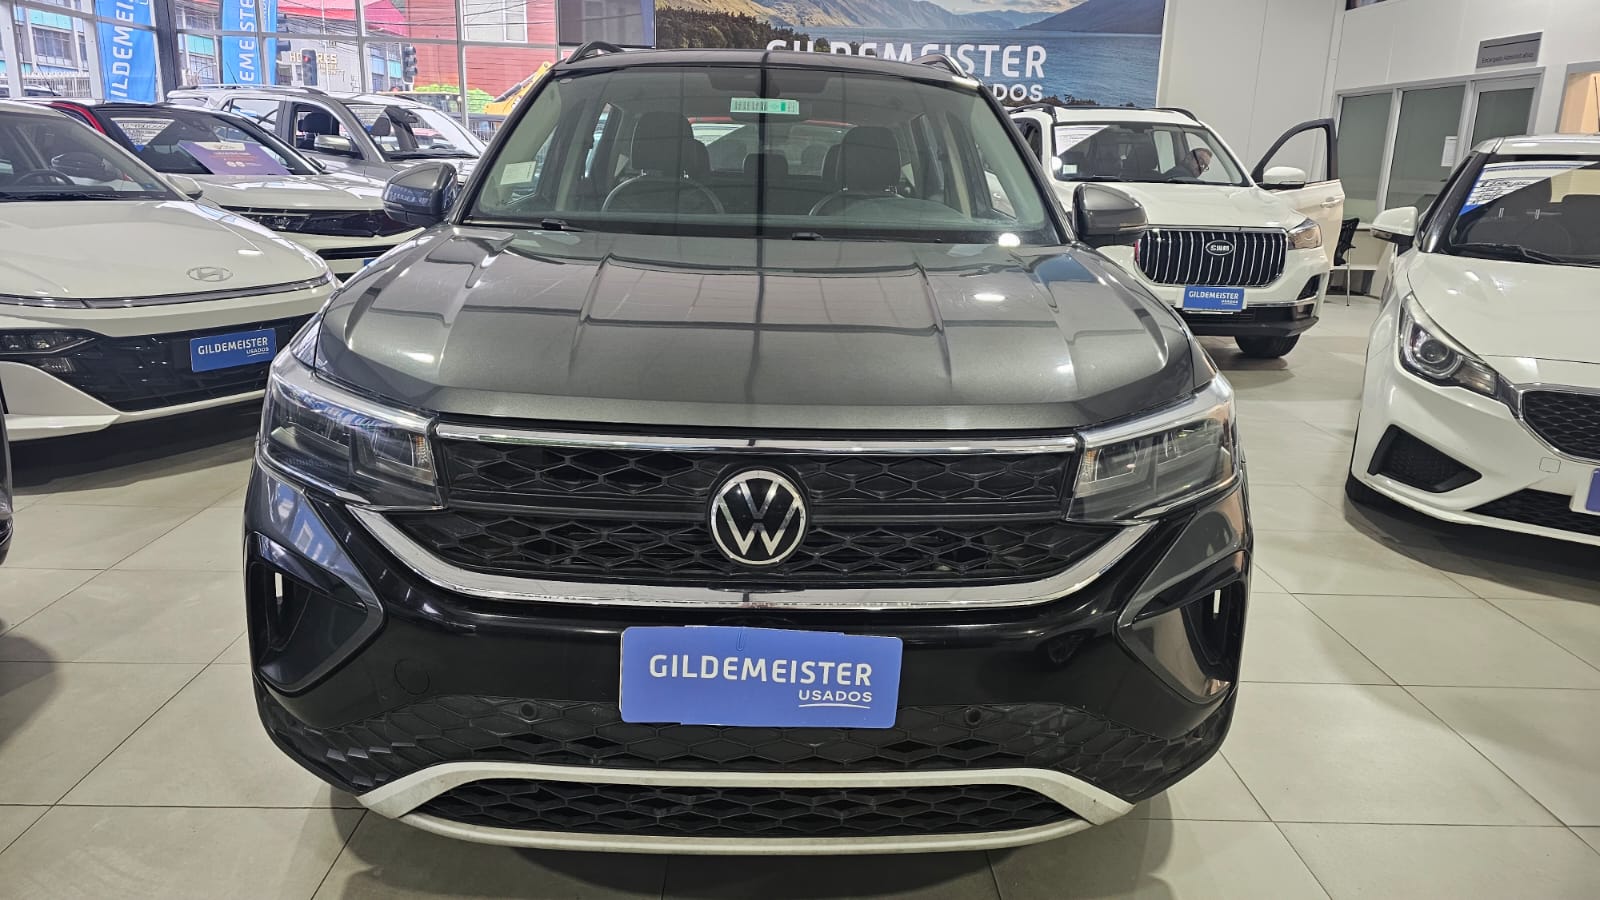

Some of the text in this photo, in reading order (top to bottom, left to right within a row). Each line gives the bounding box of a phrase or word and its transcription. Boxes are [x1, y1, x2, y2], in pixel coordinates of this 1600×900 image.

[110, 0, 134, 98] ILDEMEI
[992, 83, 1043, 102] DOS
[1188, 290, 1239, 300] GILDEMEISTER
[197, 336, 268, 355] GILDEMEISTER
[649, 654, 873, 687] GILDEMEISTER
[798, 689, 873, 702] USADOS
